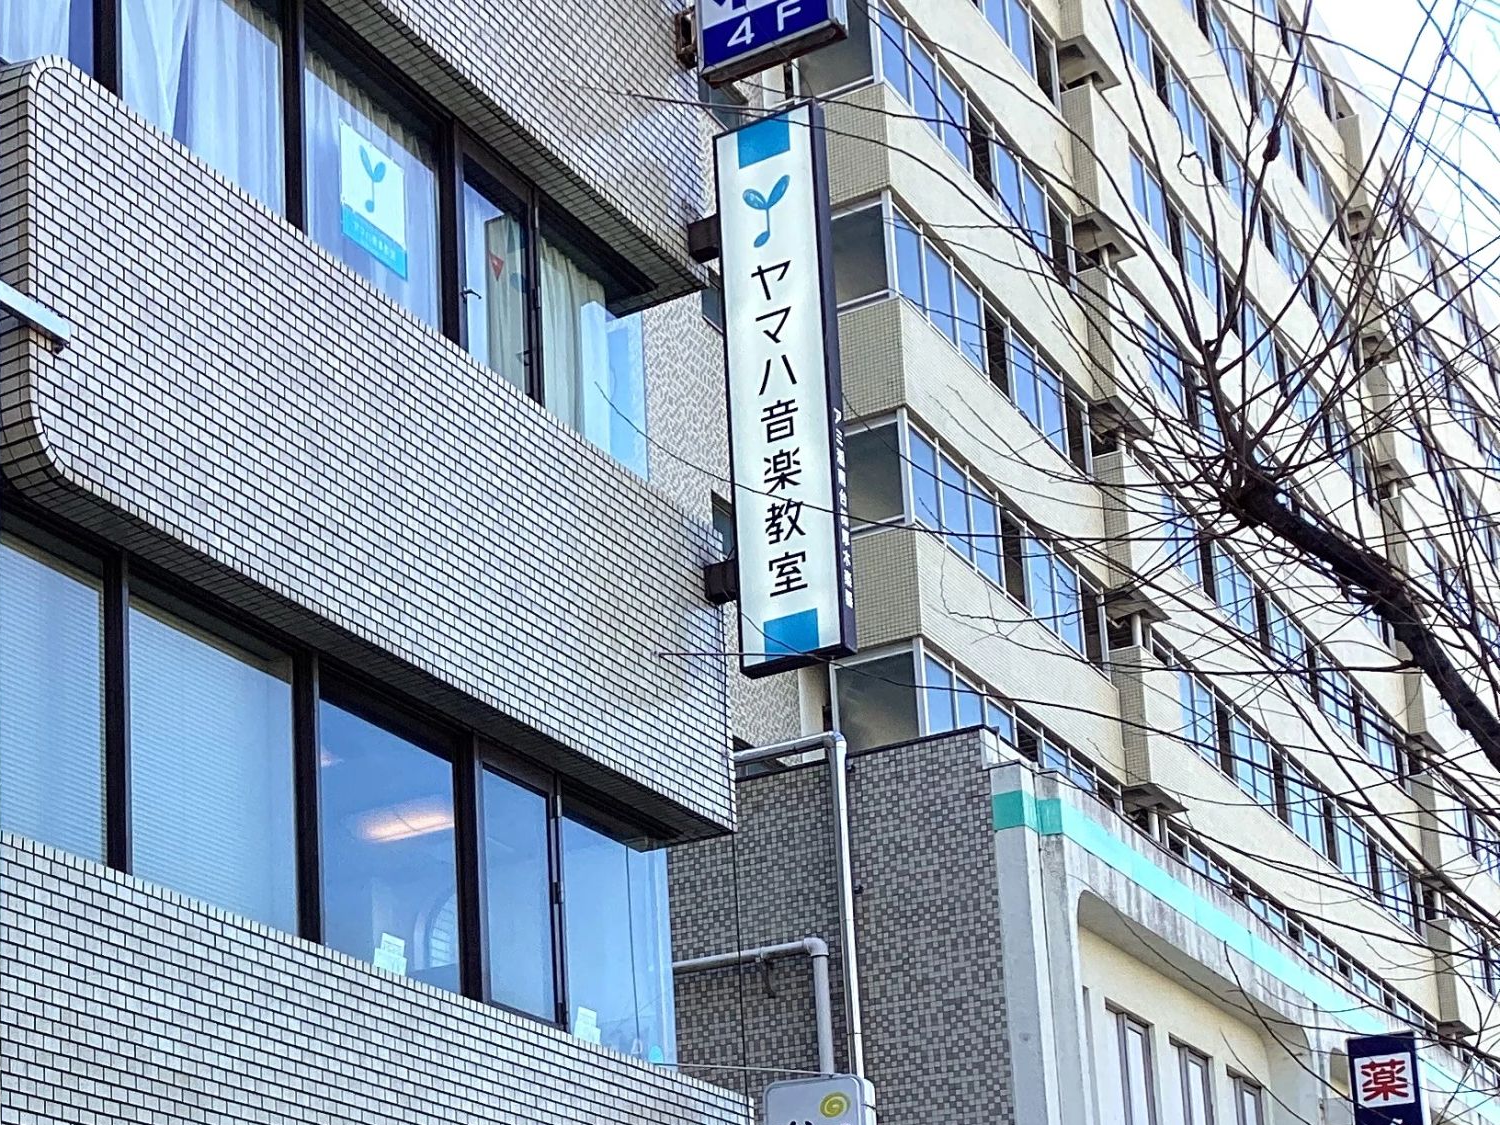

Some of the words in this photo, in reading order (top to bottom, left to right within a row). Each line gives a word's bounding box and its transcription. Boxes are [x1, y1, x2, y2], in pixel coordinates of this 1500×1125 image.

[751, 260, 809, 598] ヤマハ音楽教室
[1360, 1058, 1412, 1102] 薬
